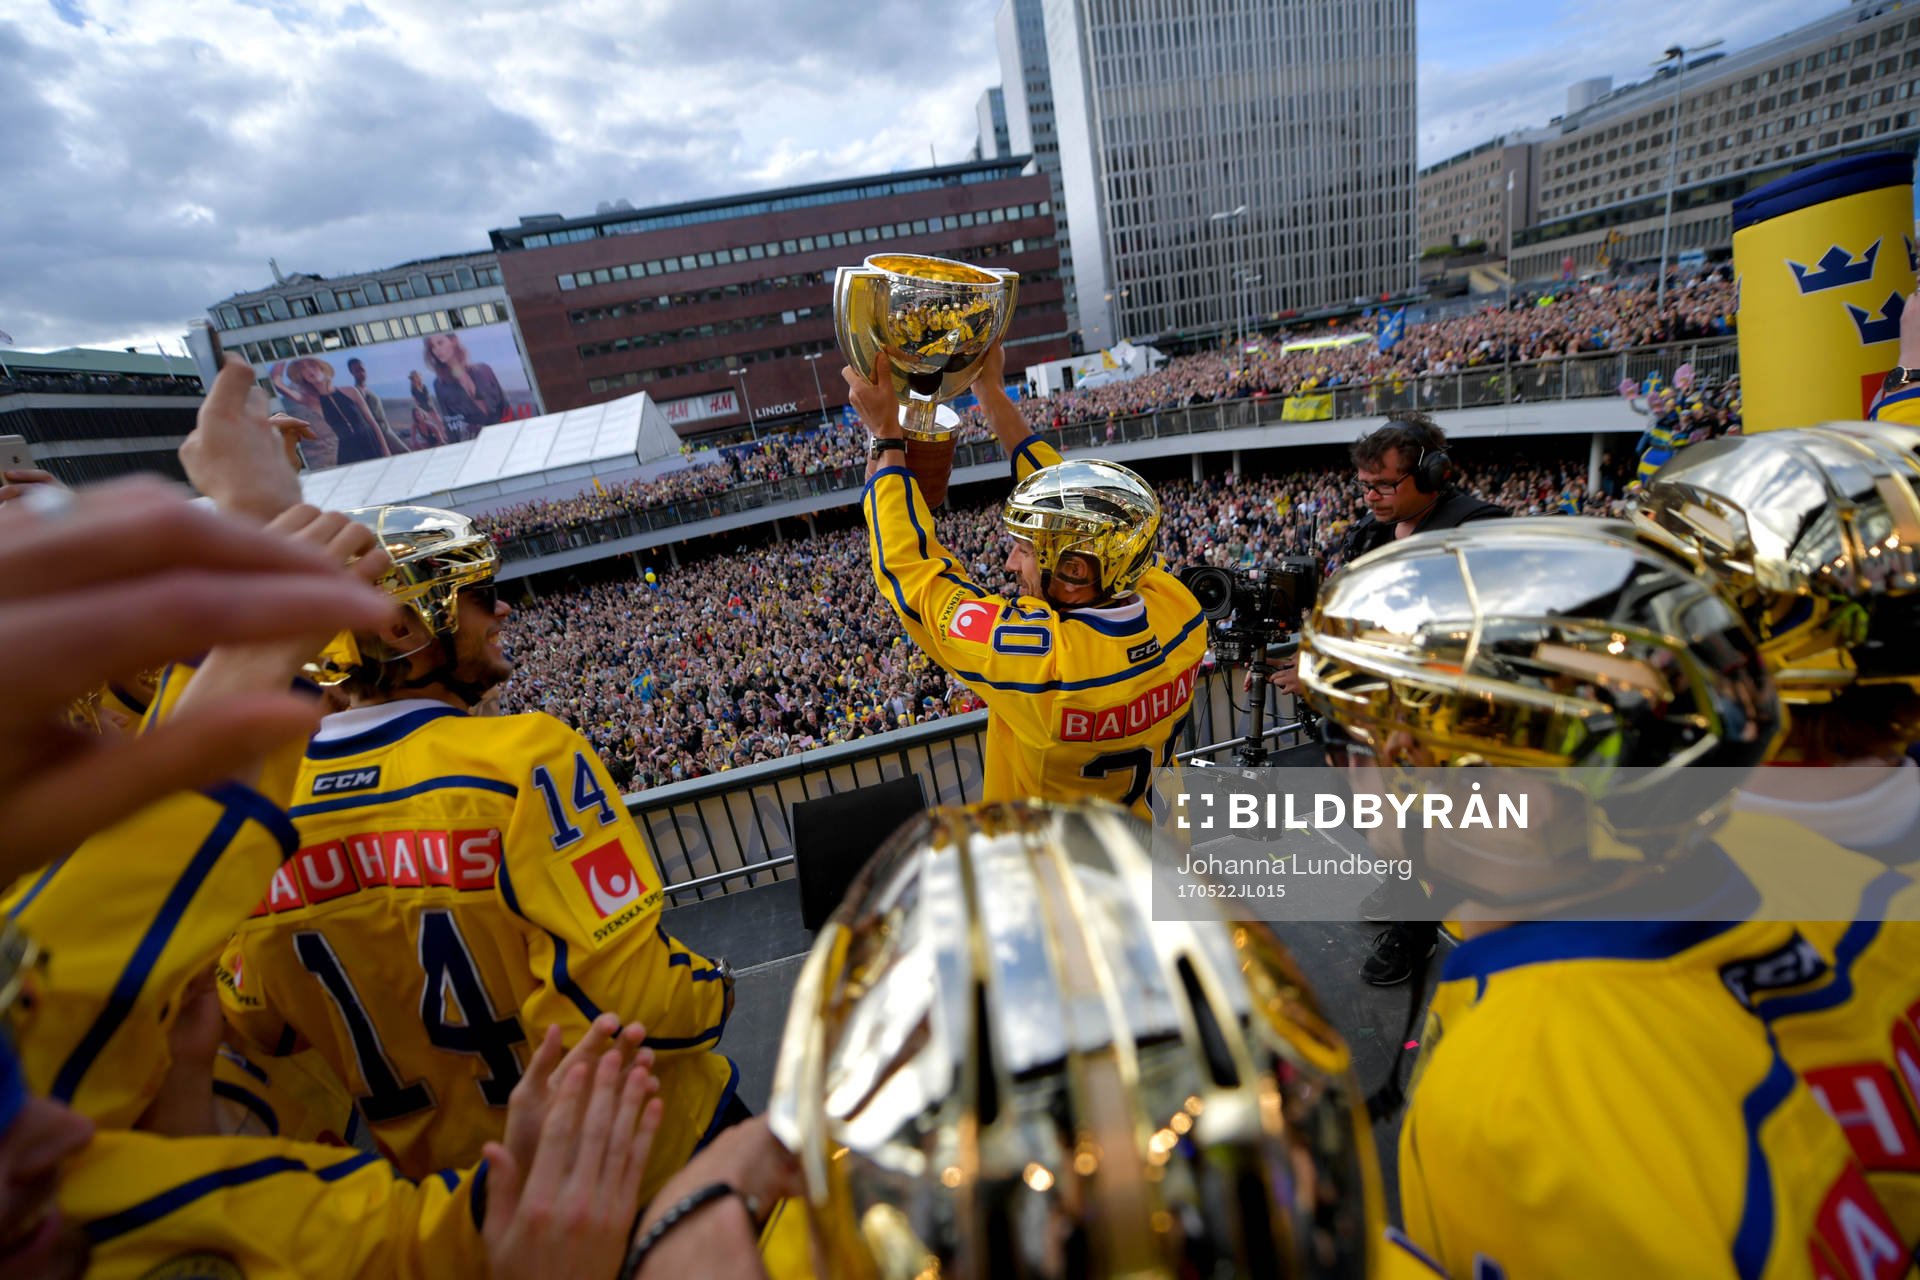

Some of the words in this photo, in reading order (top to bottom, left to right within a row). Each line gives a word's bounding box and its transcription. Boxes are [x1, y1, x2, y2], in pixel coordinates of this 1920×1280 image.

[755, 402, 798, 418] LINDEX
[312, 769, 378, 792] CCM
[533, 751, 618, 850] 14
[270, 836, 497, 905] AUHAUS
[292, 908, 526, 1121] 14
